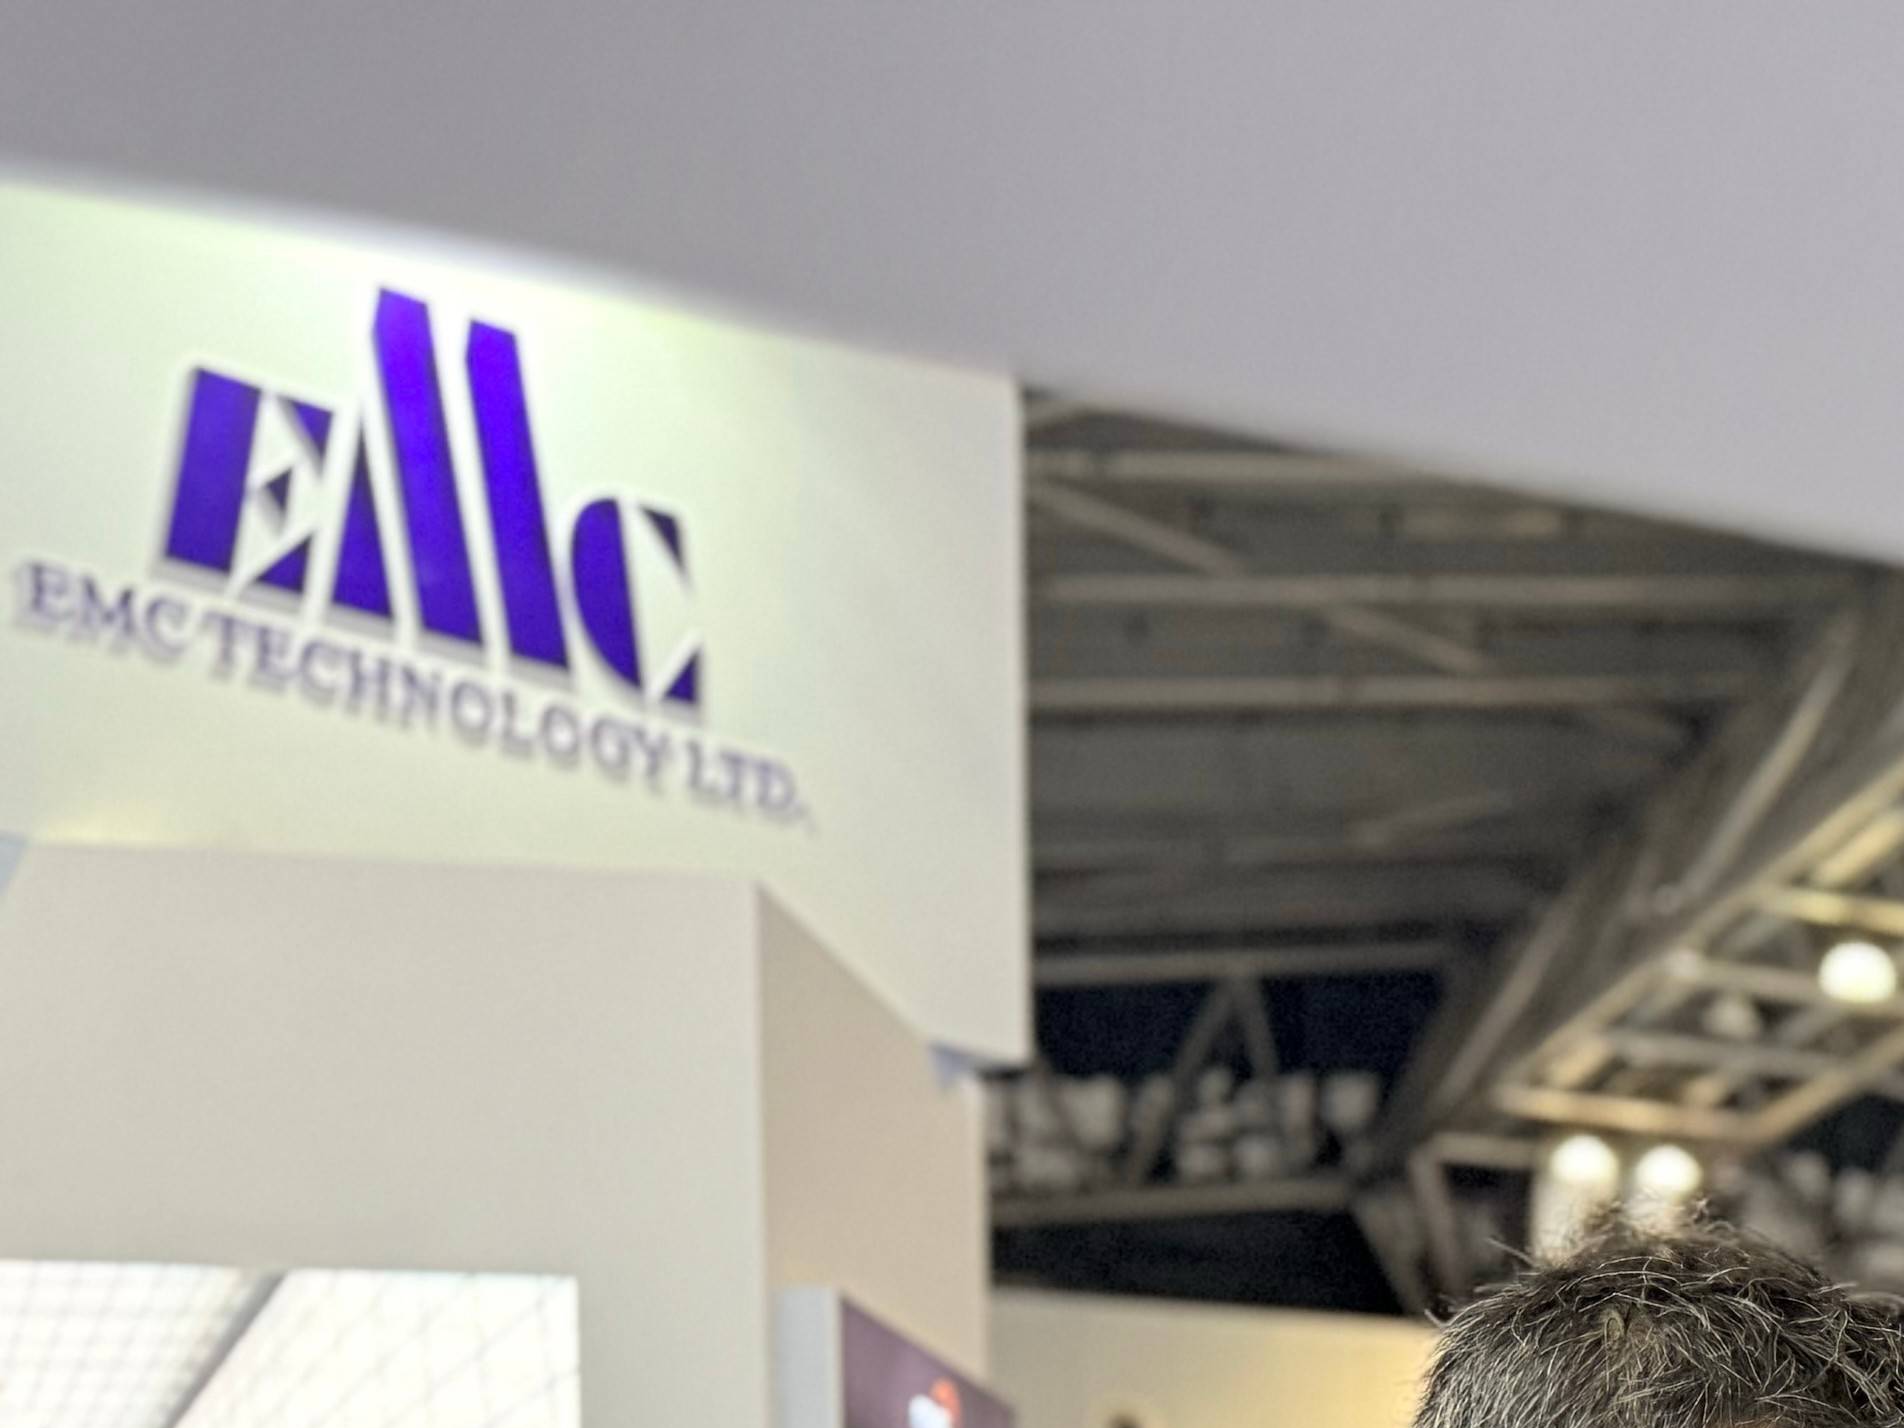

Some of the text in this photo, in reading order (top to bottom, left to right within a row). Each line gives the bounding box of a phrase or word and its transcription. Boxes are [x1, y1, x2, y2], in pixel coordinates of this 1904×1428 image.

[162, 286, 708, 708] EMC
[22, 562, 190, 658] EMC
[200, 606, 674, 786] TECHNOLOGY
